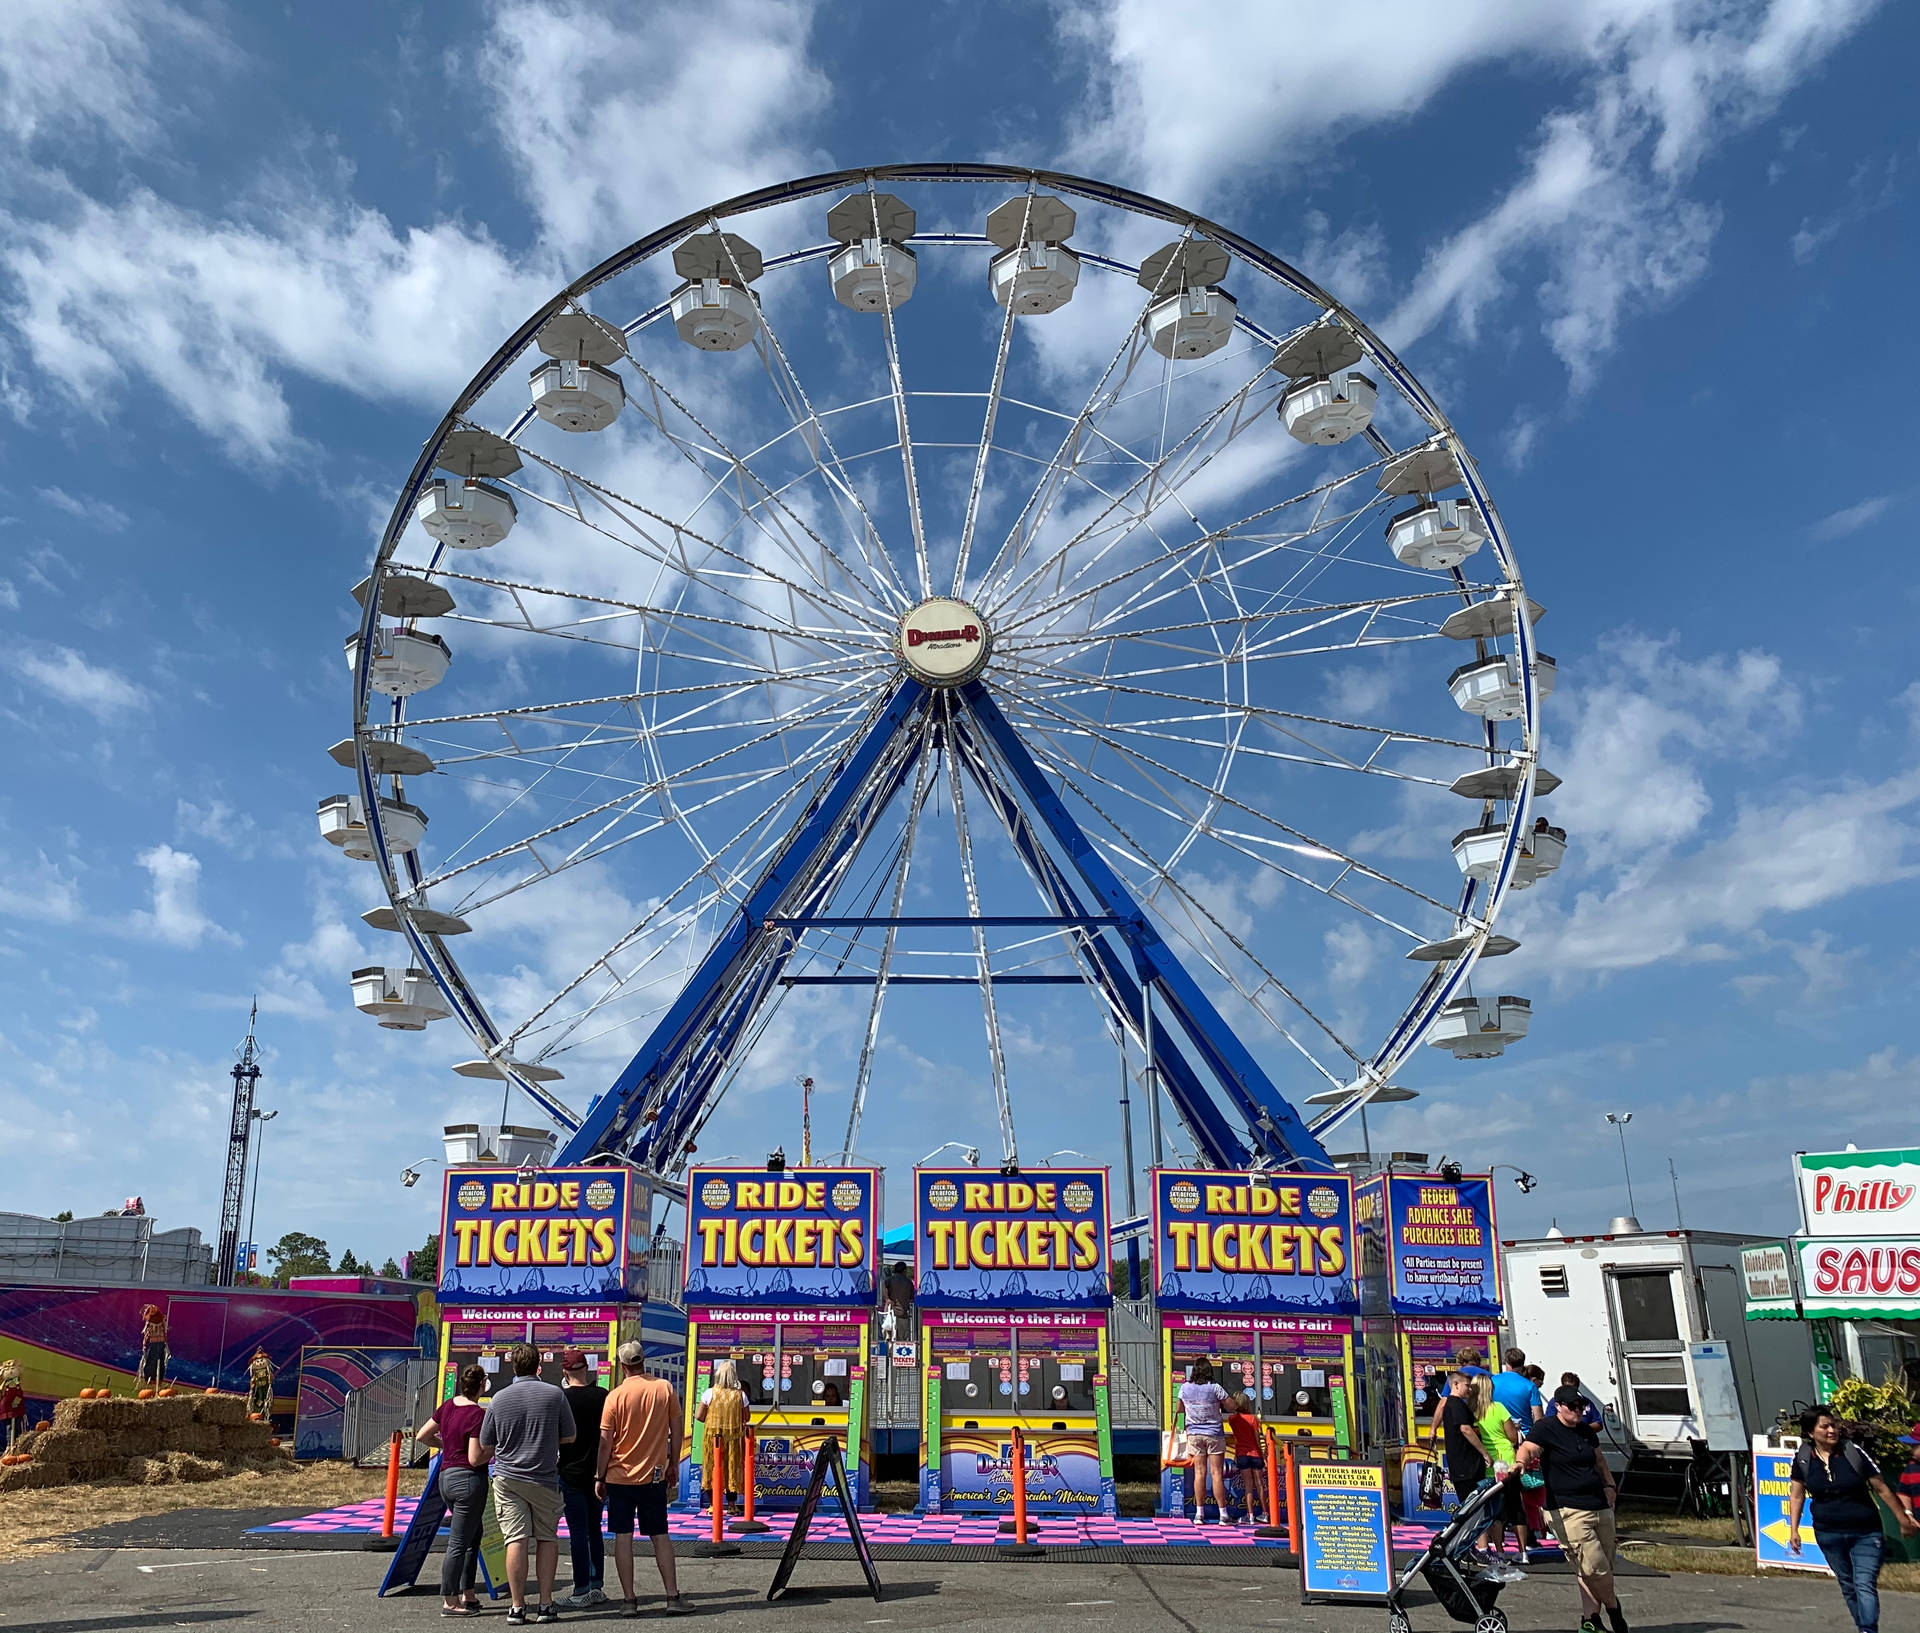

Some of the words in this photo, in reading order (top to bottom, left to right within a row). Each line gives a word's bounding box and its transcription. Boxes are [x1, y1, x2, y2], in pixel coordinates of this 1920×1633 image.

[490, 1182, 580, 1211] RIDE
[734, 1181, 826, 1211] RIDE
[963, 1182, 1056, 1213] RIDE
[1204, 1184, 1302, 1216] RIDE
[1421, 1188, 1457, 1205] REDEEM
[1815, 1174, 1914, 1213] Philly
[1357, 1192, 1375, 1224] RIDE
[1408, 1208, 1449, 1225] ADVANCE
[1452, 1208, 1472, 1225] SALE
[453, 1217, 617, 1267] TICKETS
[697, 1218, 864, 1269] TICKETS
[927, 1218, 1100, 1271] TICKETS
[1403, 1227, 1455, 1244] PURCHASES
[1457, 1228, 1481, 1245] HERE
[1167, 1220, 1346, 1277] TICKETS
[1415, 1257, 1435, 1269] Parties
[1437, 1259, 1450, 1268] must
[1452, 1258, 1459, 1269] be
[1461, 1260, 1482, 1271] present
[1407, 1273, 1414, 1282] to
[1414, 1272, 1429, 1283] have
[1430, 1272, 1458, 1284] wristband
[1460, 1274, 1470, 1286] put
[462, 1309, 523, 1320] Welcome
[527, 1310, 540, 1320] to
[544, 1309, 566, 1319] the
[569, 1309, 600, 1319] Fair!
[709, 1310, 772, 1321] Welcome
[776, 1312, 790, 1321] to
[793, 1311, 816, 1321] the
[819, 1311, 851, 1321] Fair!
[941, 1312, 1006, 1324] Welcome
[1010, 1314, 1024, 1324] to
[1027, 1314, 1050, 1324] the
[1054, 1313, 1086, 1324] Fair!
[1184, 1315, 1251, 1328] Welcome
[1253, 1318, 1269, 1329] to
[1272, 1318, 1296, 1329] the
[1299, 1319, 1332, 1330] Fair!
[1403, 1320, 1444, 1331] Welcome
[1445, 1322, 1455, 1331] to
[1456, 1322, 1471, 1332] the
[1473, 1321, 1494, 1332] Fair!
[754, 1484, 807, 1499] Spectacular
[941, 1488, 992, 1502] America's
[1055, 1489, 1099, 1508] Midway
